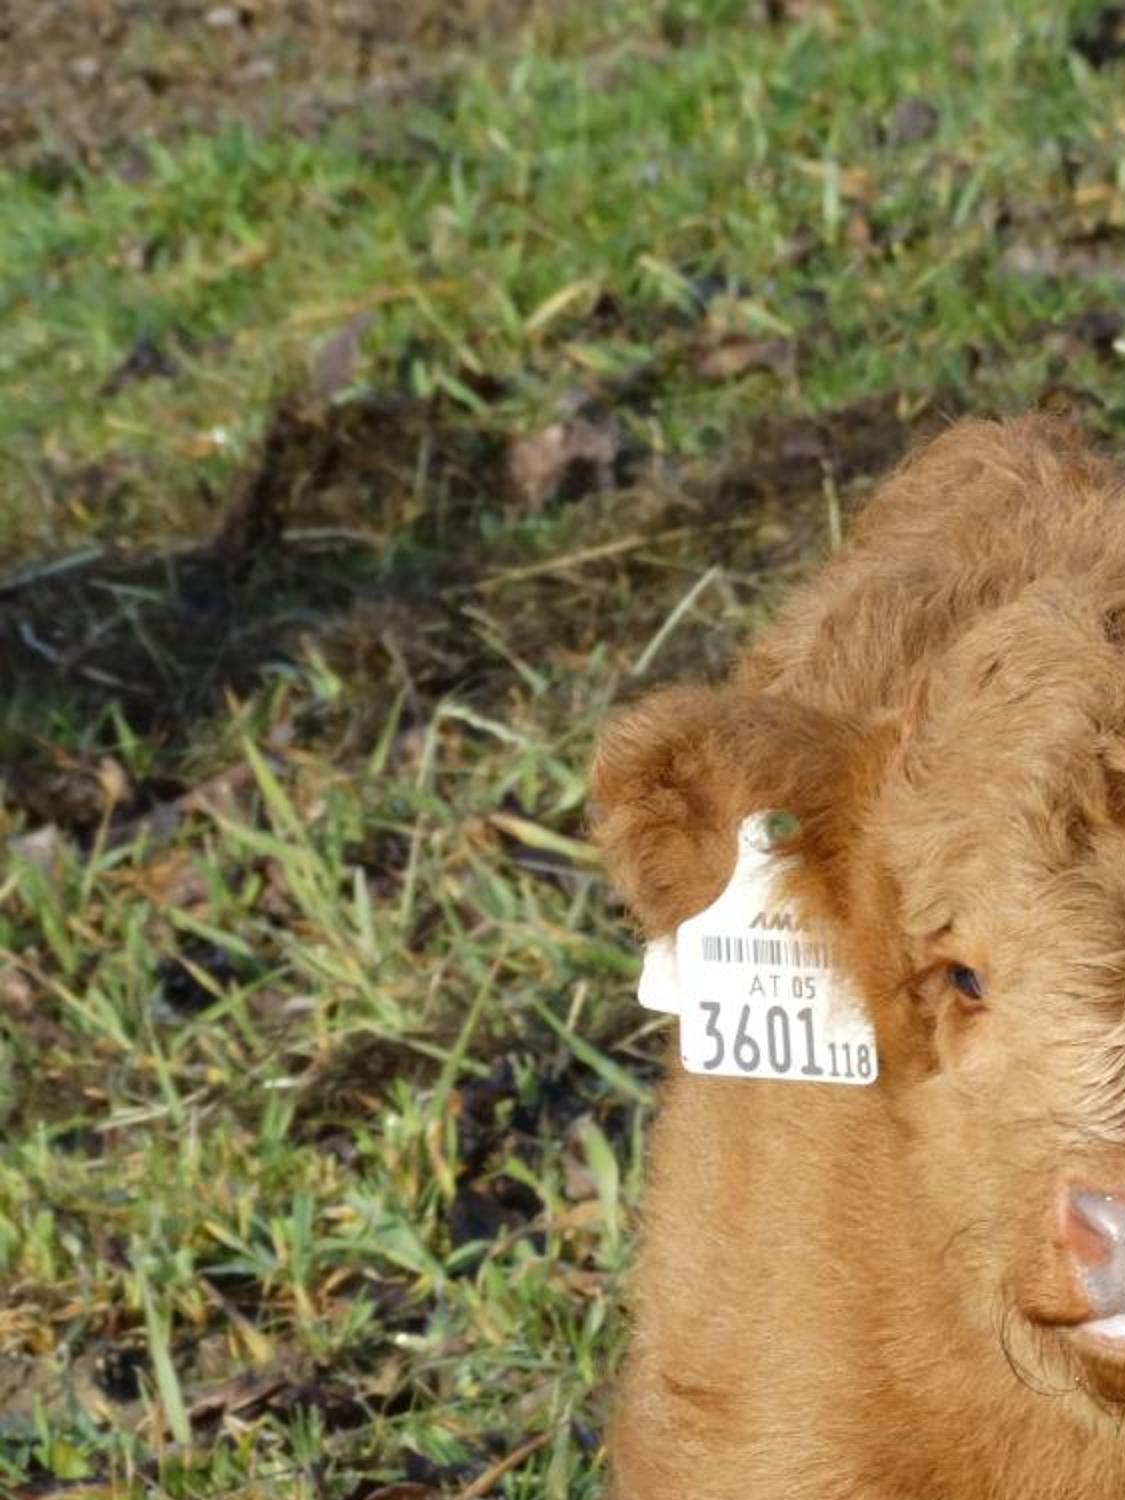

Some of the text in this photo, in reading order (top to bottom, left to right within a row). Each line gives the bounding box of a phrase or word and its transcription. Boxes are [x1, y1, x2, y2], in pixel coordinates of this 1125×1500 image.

[749, 974, 816, 999] AT 05
[699, 1001, 871, 1078] 3601 118
